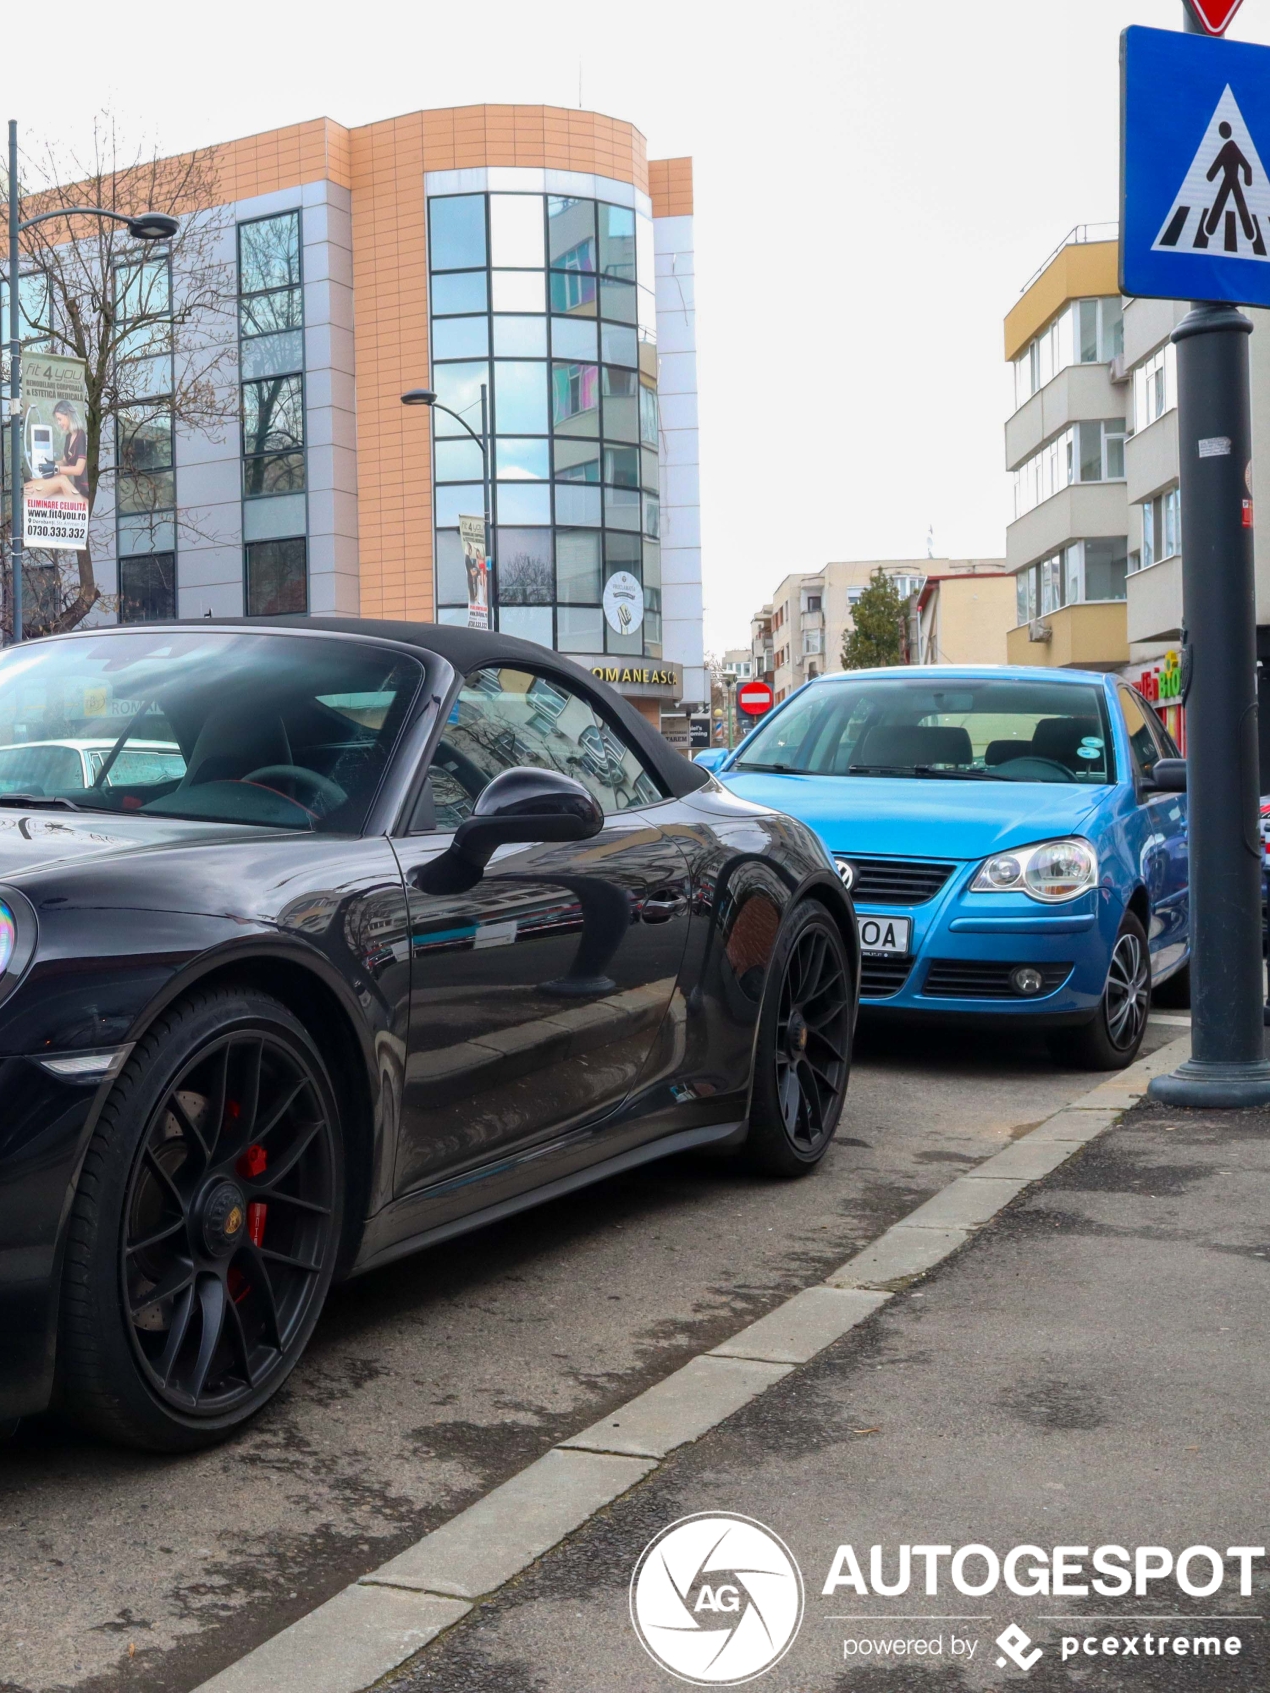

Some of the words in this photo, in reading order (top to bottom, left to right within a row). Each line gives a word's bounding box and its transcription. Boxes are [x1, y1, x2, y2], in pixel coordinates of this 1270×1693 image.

[26, 363, 41, 376] fit
[43, 366, 52, 380] 4
[55, 369, 82, 381] you
[28, 499, 58, 509] ELIMINARE
[28, 509, 86, 520] www.fit4you.ro
[28, 525, 85, 538] 0730.333.332
[468, 522, 473, 532] 4
